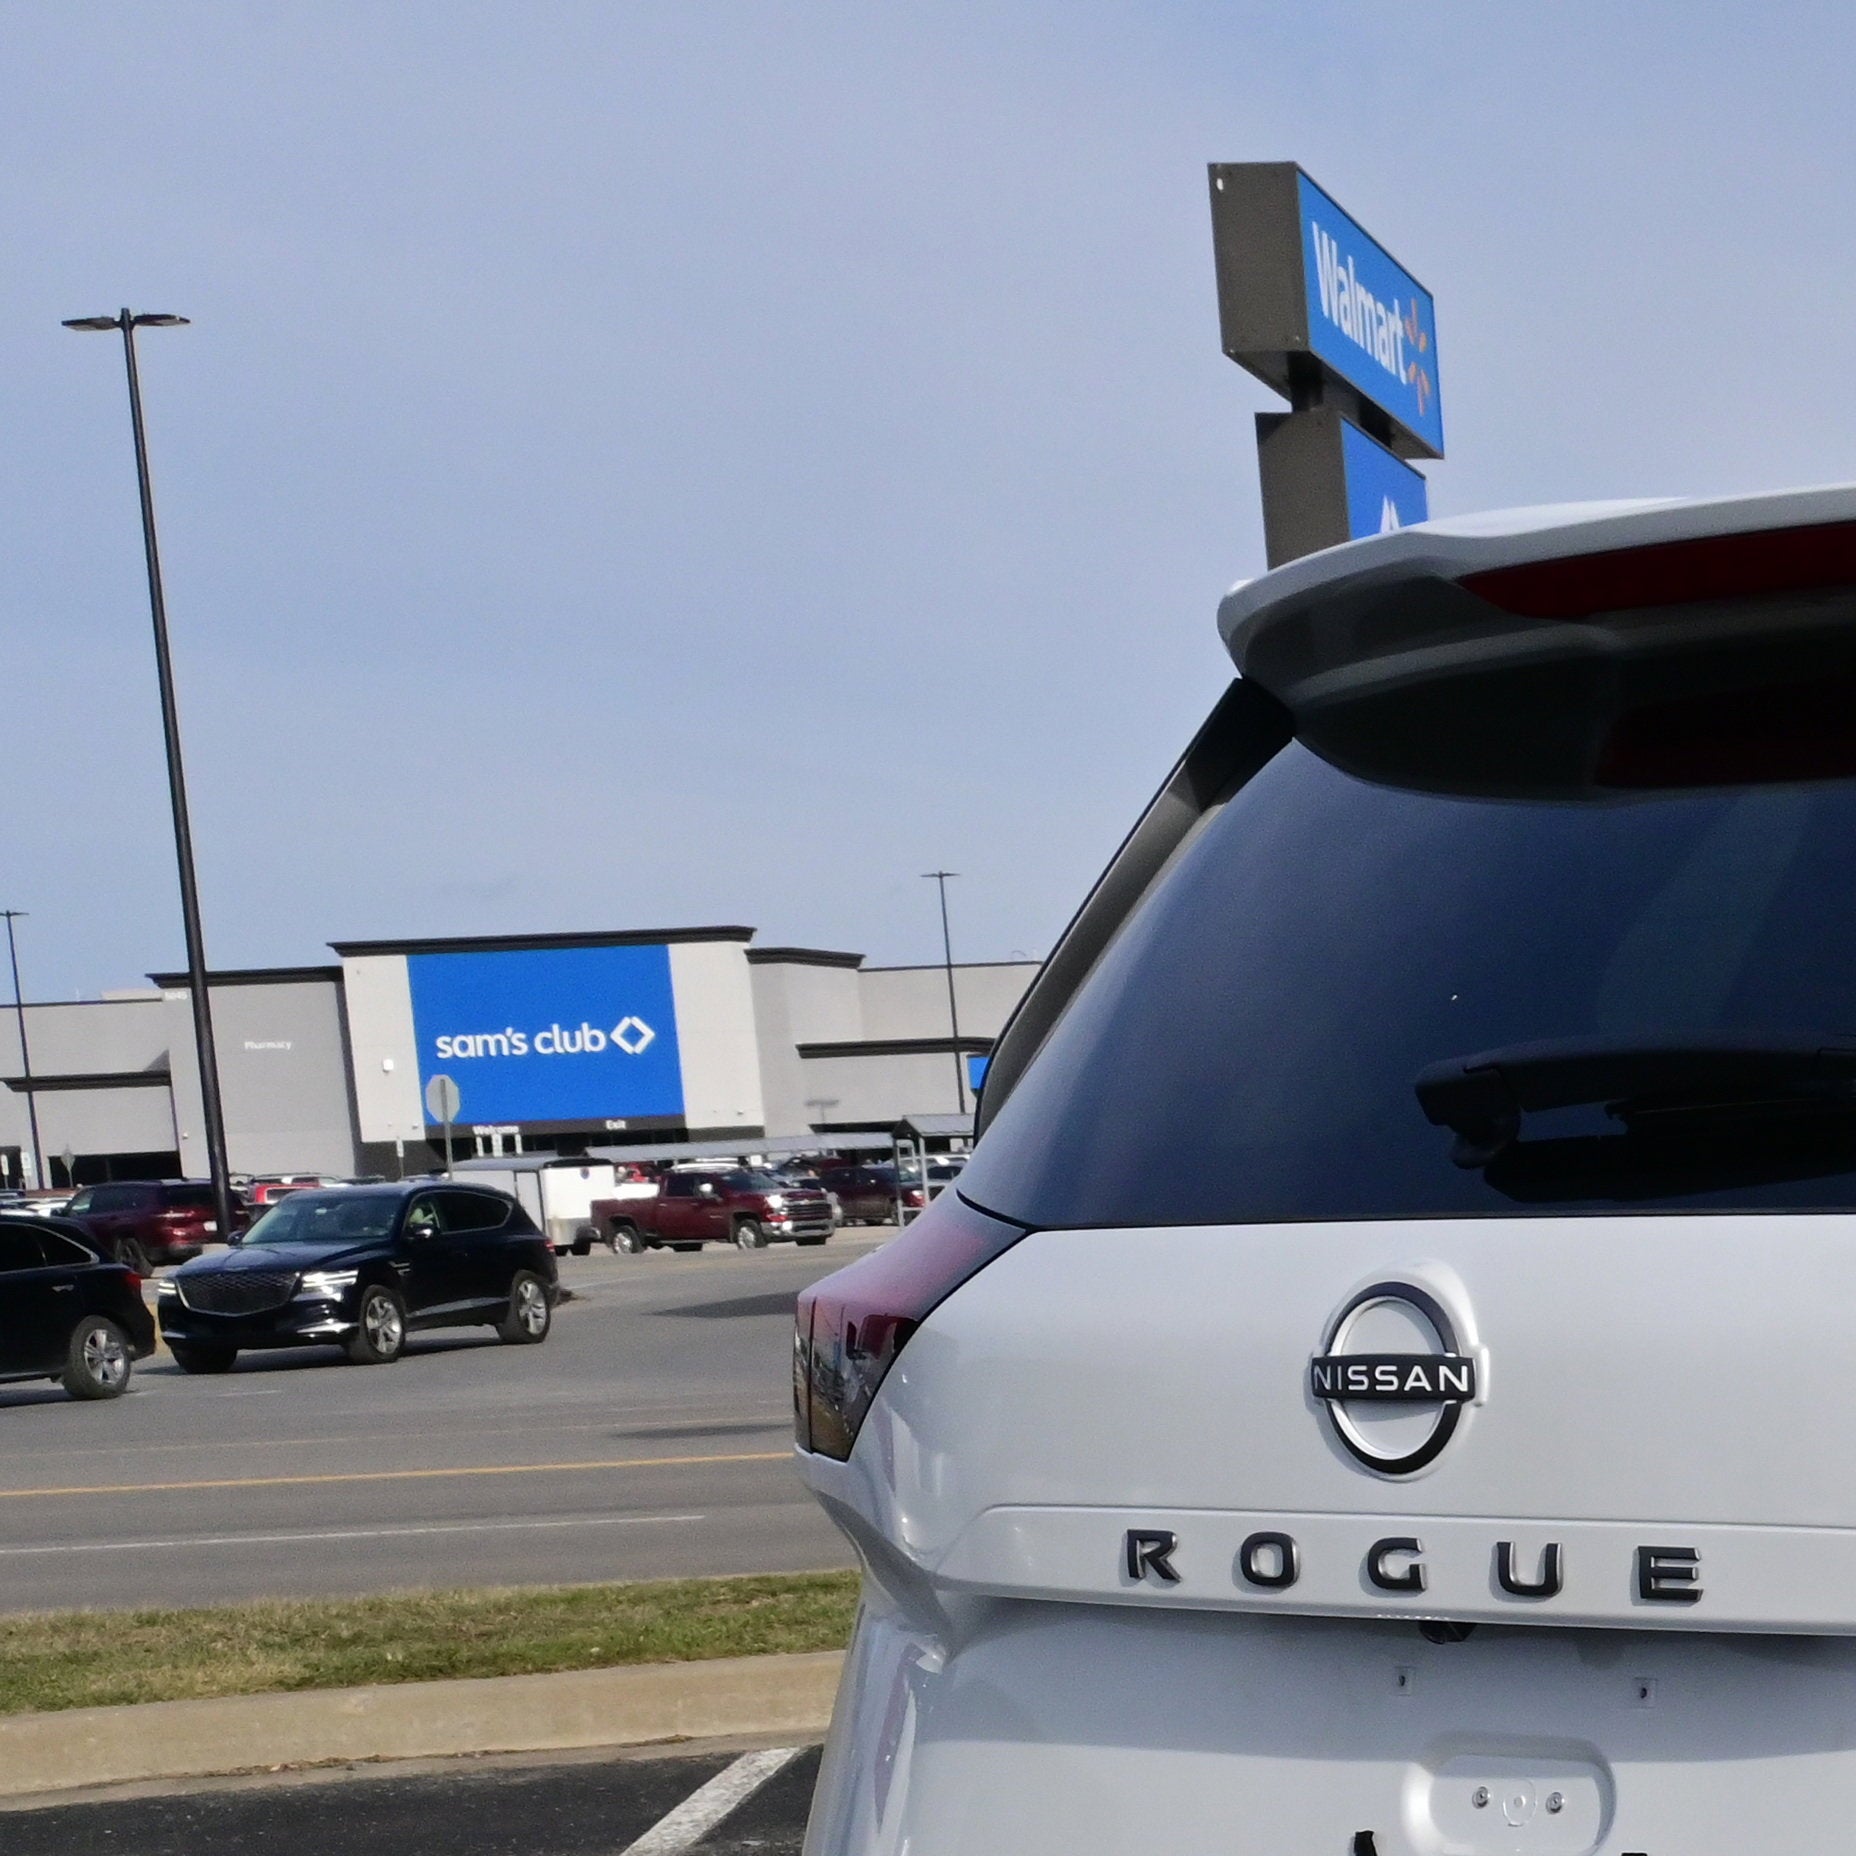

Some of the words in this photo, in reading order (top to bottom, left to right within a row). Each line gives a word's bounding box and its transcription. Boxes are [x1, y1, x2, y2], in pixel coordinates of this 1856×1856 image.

[1312, 221, 1407, 385] Walmart
[244, 1041, 292, 1050] Pharmacy
[436, 1027, 528, 1059] sam's
[534, 1022, 607, 1054] club
[472, 1125, 519, 1136] Welcome
[605, 1119, 626, 1130] Exit
[1313, 1365, 1468, 1392] NISSAN
[1126, 1529, 1702, 1601] ROGUE
